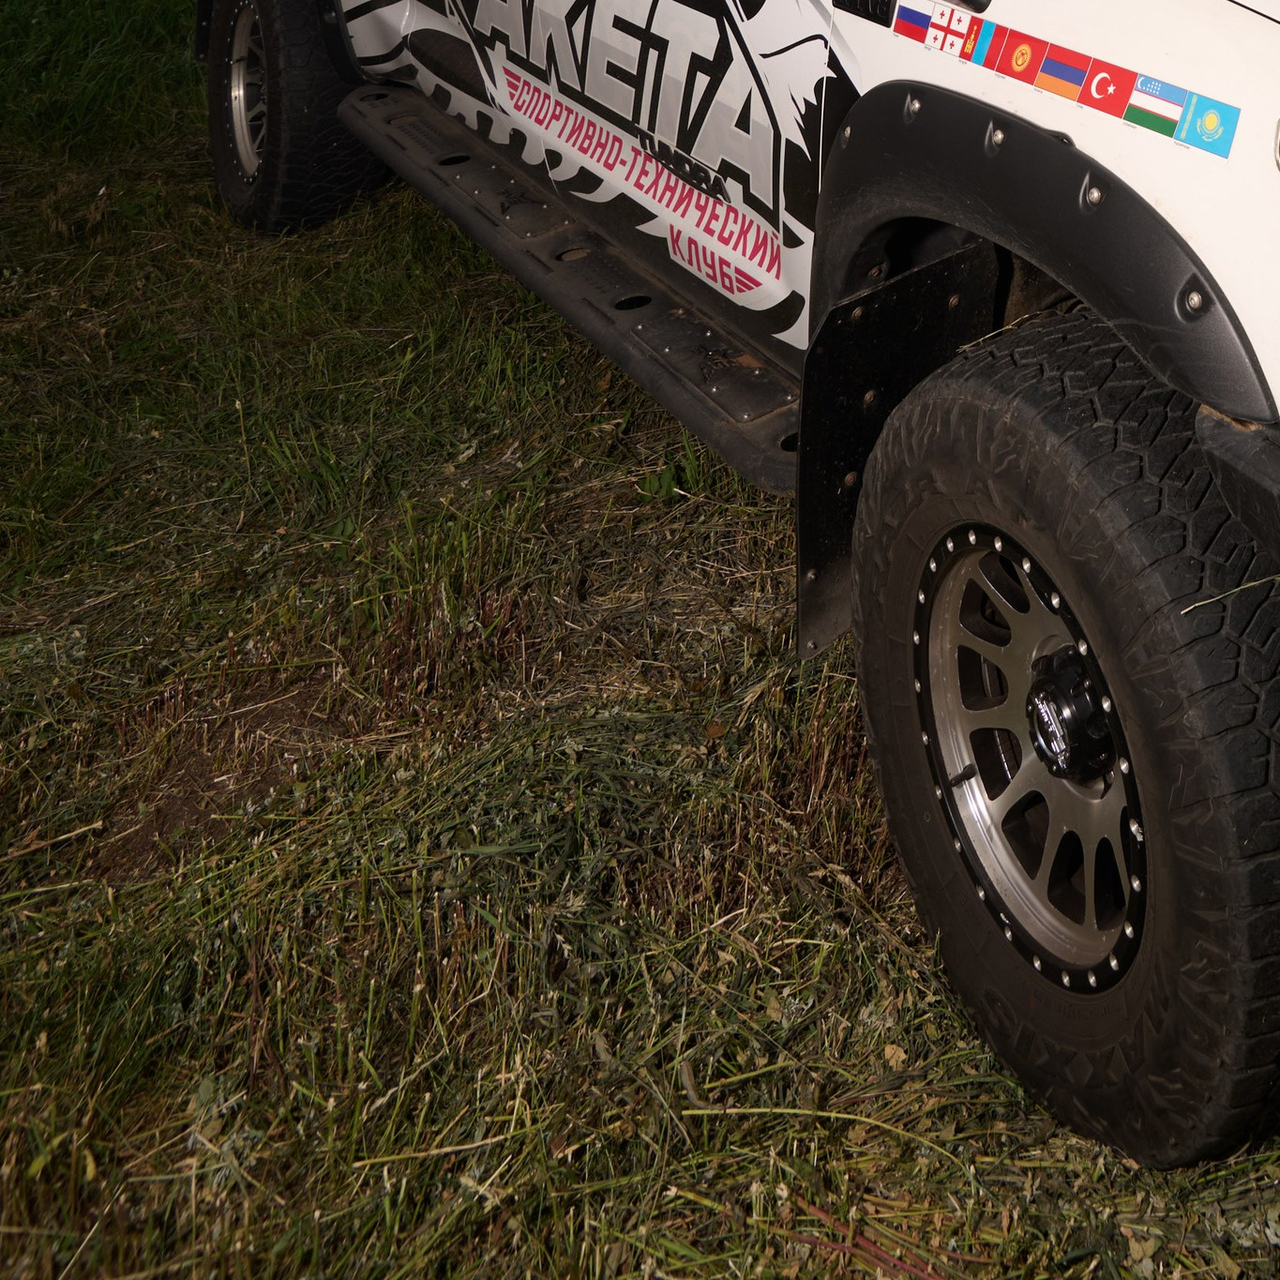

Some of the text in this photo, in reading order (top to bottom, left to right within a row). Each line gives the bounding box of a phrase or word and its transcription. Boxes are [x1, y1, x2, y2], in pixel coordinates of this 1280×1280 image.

[513, 79, 782, 281] СПОРТИВНО-ТЕХНИЧЕСКИЙ
[634, 124, 732, 205] TUNDRA
[669, 223, 736, 295] КЛУБ
